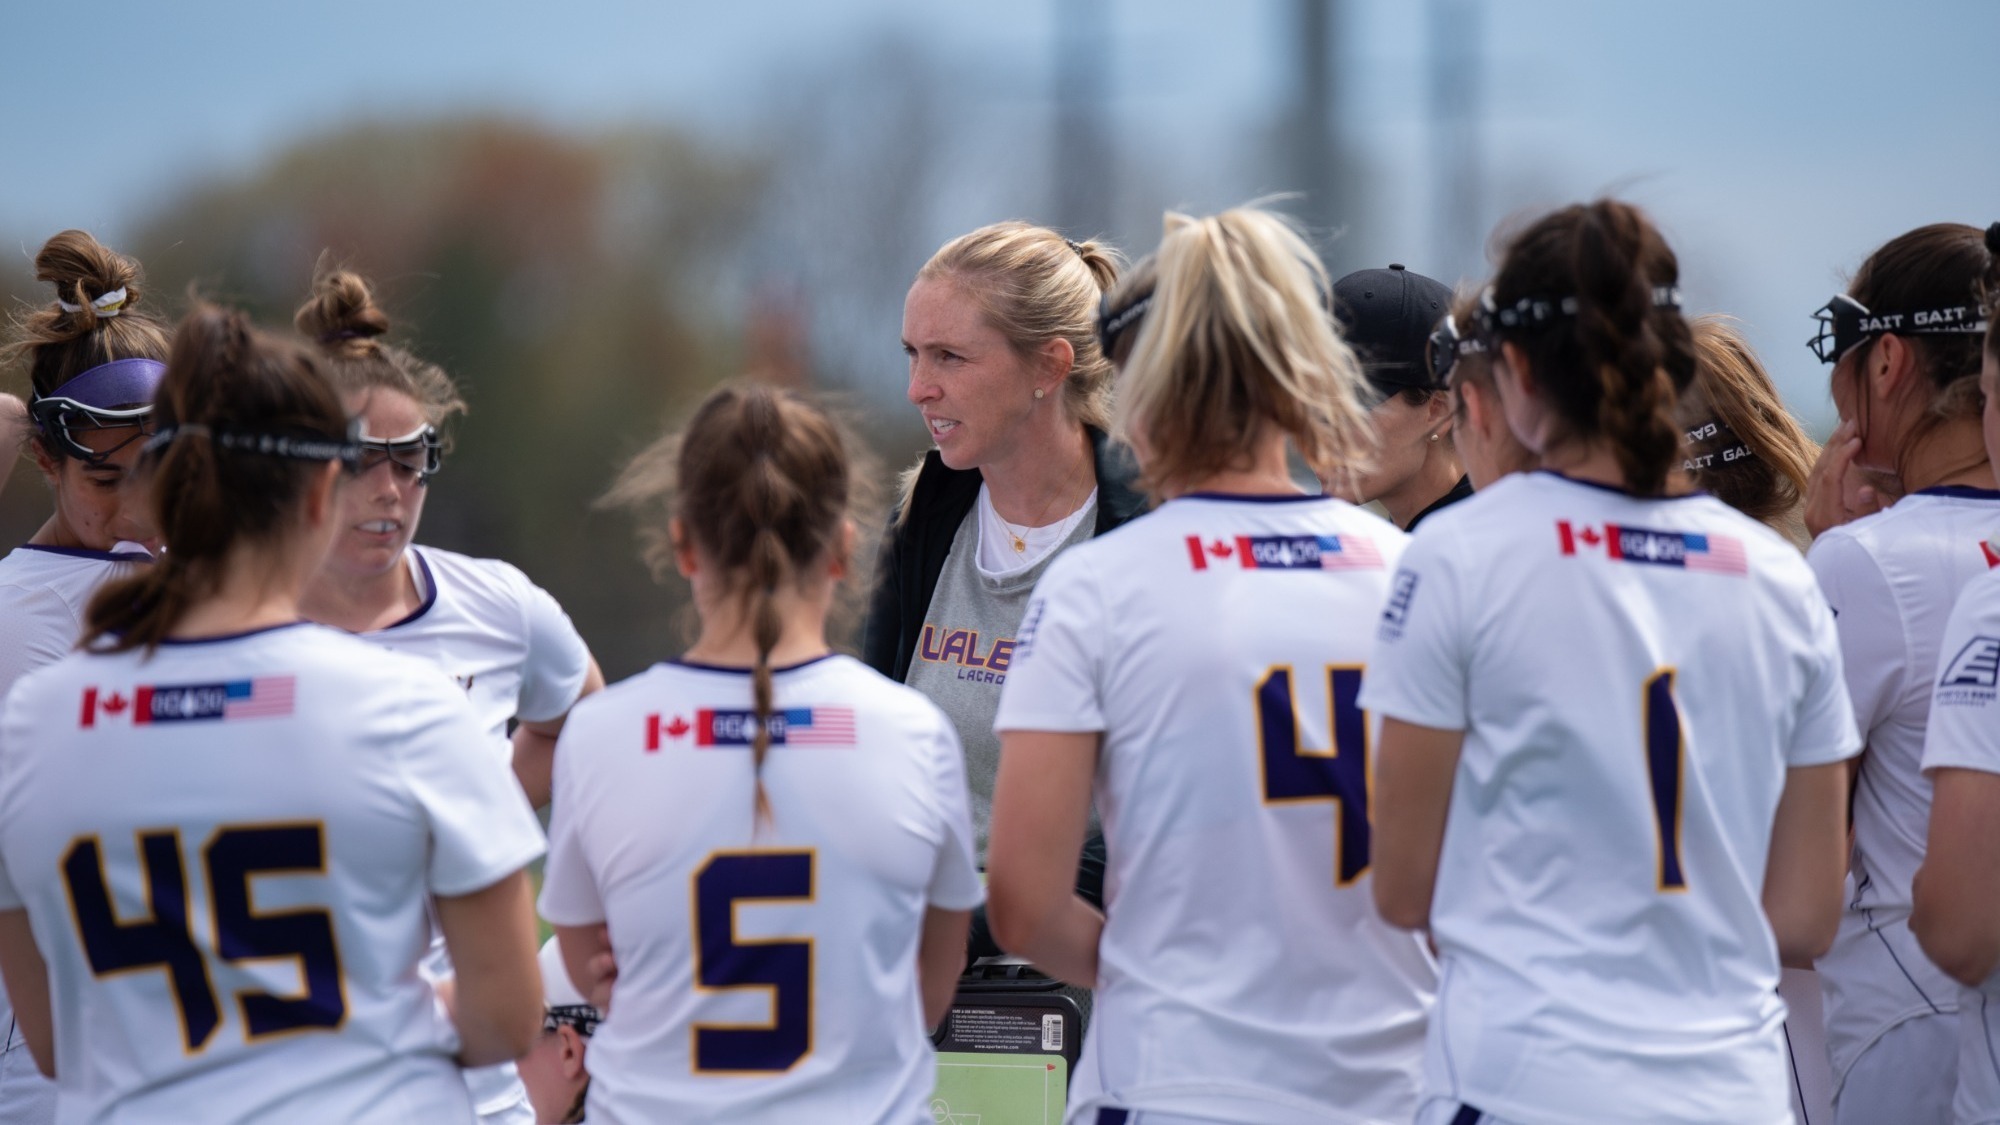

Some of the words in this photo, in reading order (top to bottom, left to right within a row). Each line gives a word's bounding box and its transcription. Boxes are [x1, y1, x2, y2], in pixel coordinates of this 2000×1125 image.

[1913, 306, 1966, 325] GAIT
[1682, 454, 1714, 471] AIT
[1722, 444, 1753, 462] GAI
[1683, 422, 1718, 446] GAI
[957, 668, 1006, 686] LACRO
[1253, 663, 1373, 887] 4
[1642, 666, 1689, 893] 1
[60, 820, 349, 1056] 45
[689, 846, 818, 1077] 5
